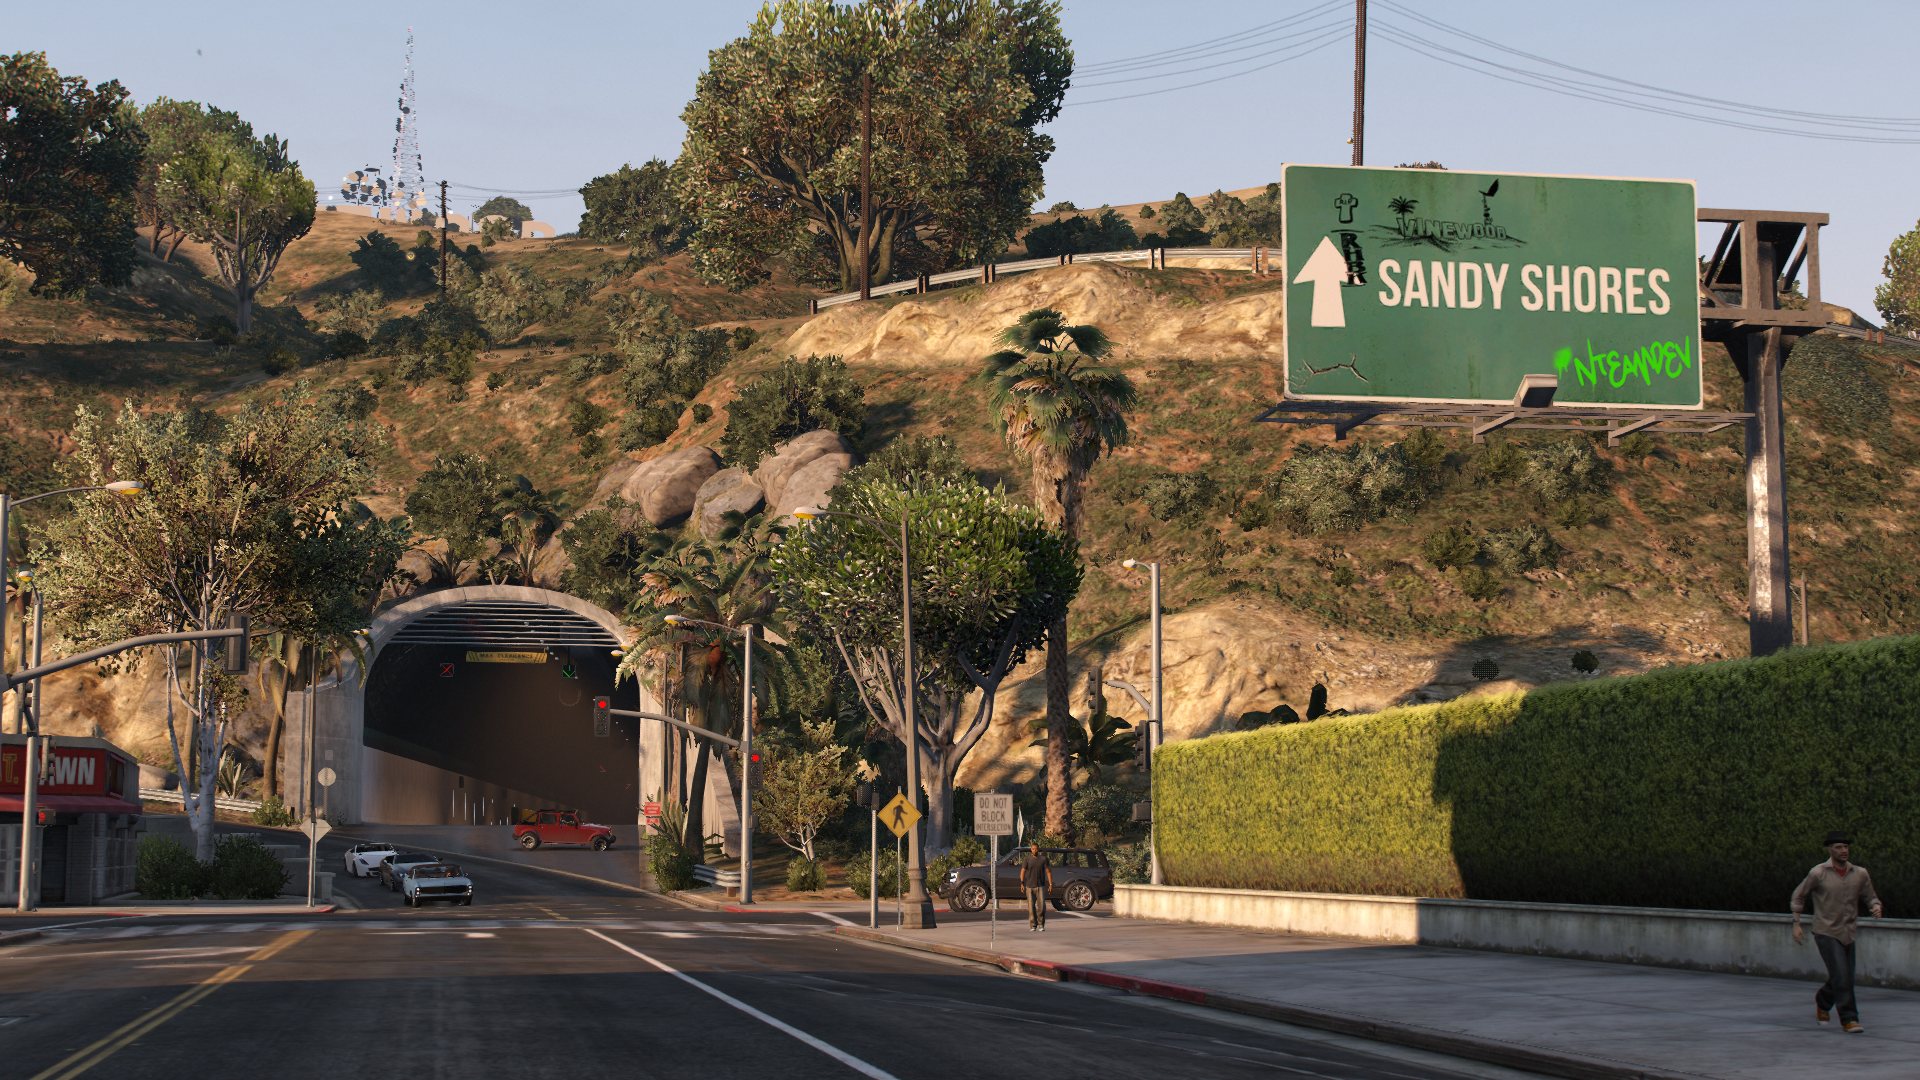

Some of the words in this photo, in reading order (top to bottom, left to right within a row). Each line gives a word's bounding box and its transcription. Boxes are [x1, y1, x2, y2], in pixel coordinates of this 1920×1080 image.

[1397, 217, 1507, 240] VINEWOOD
[1378, 258, 1510, 310] SANDY
[1520, 263, 1671, 316] SHORES
[979, 797, 989, 808] DO
[993, 797, 1007, 808] NOT
[981, 810, 1005, 822] BLOCK
[976, 823, 1011, 831] INTERSECTION
